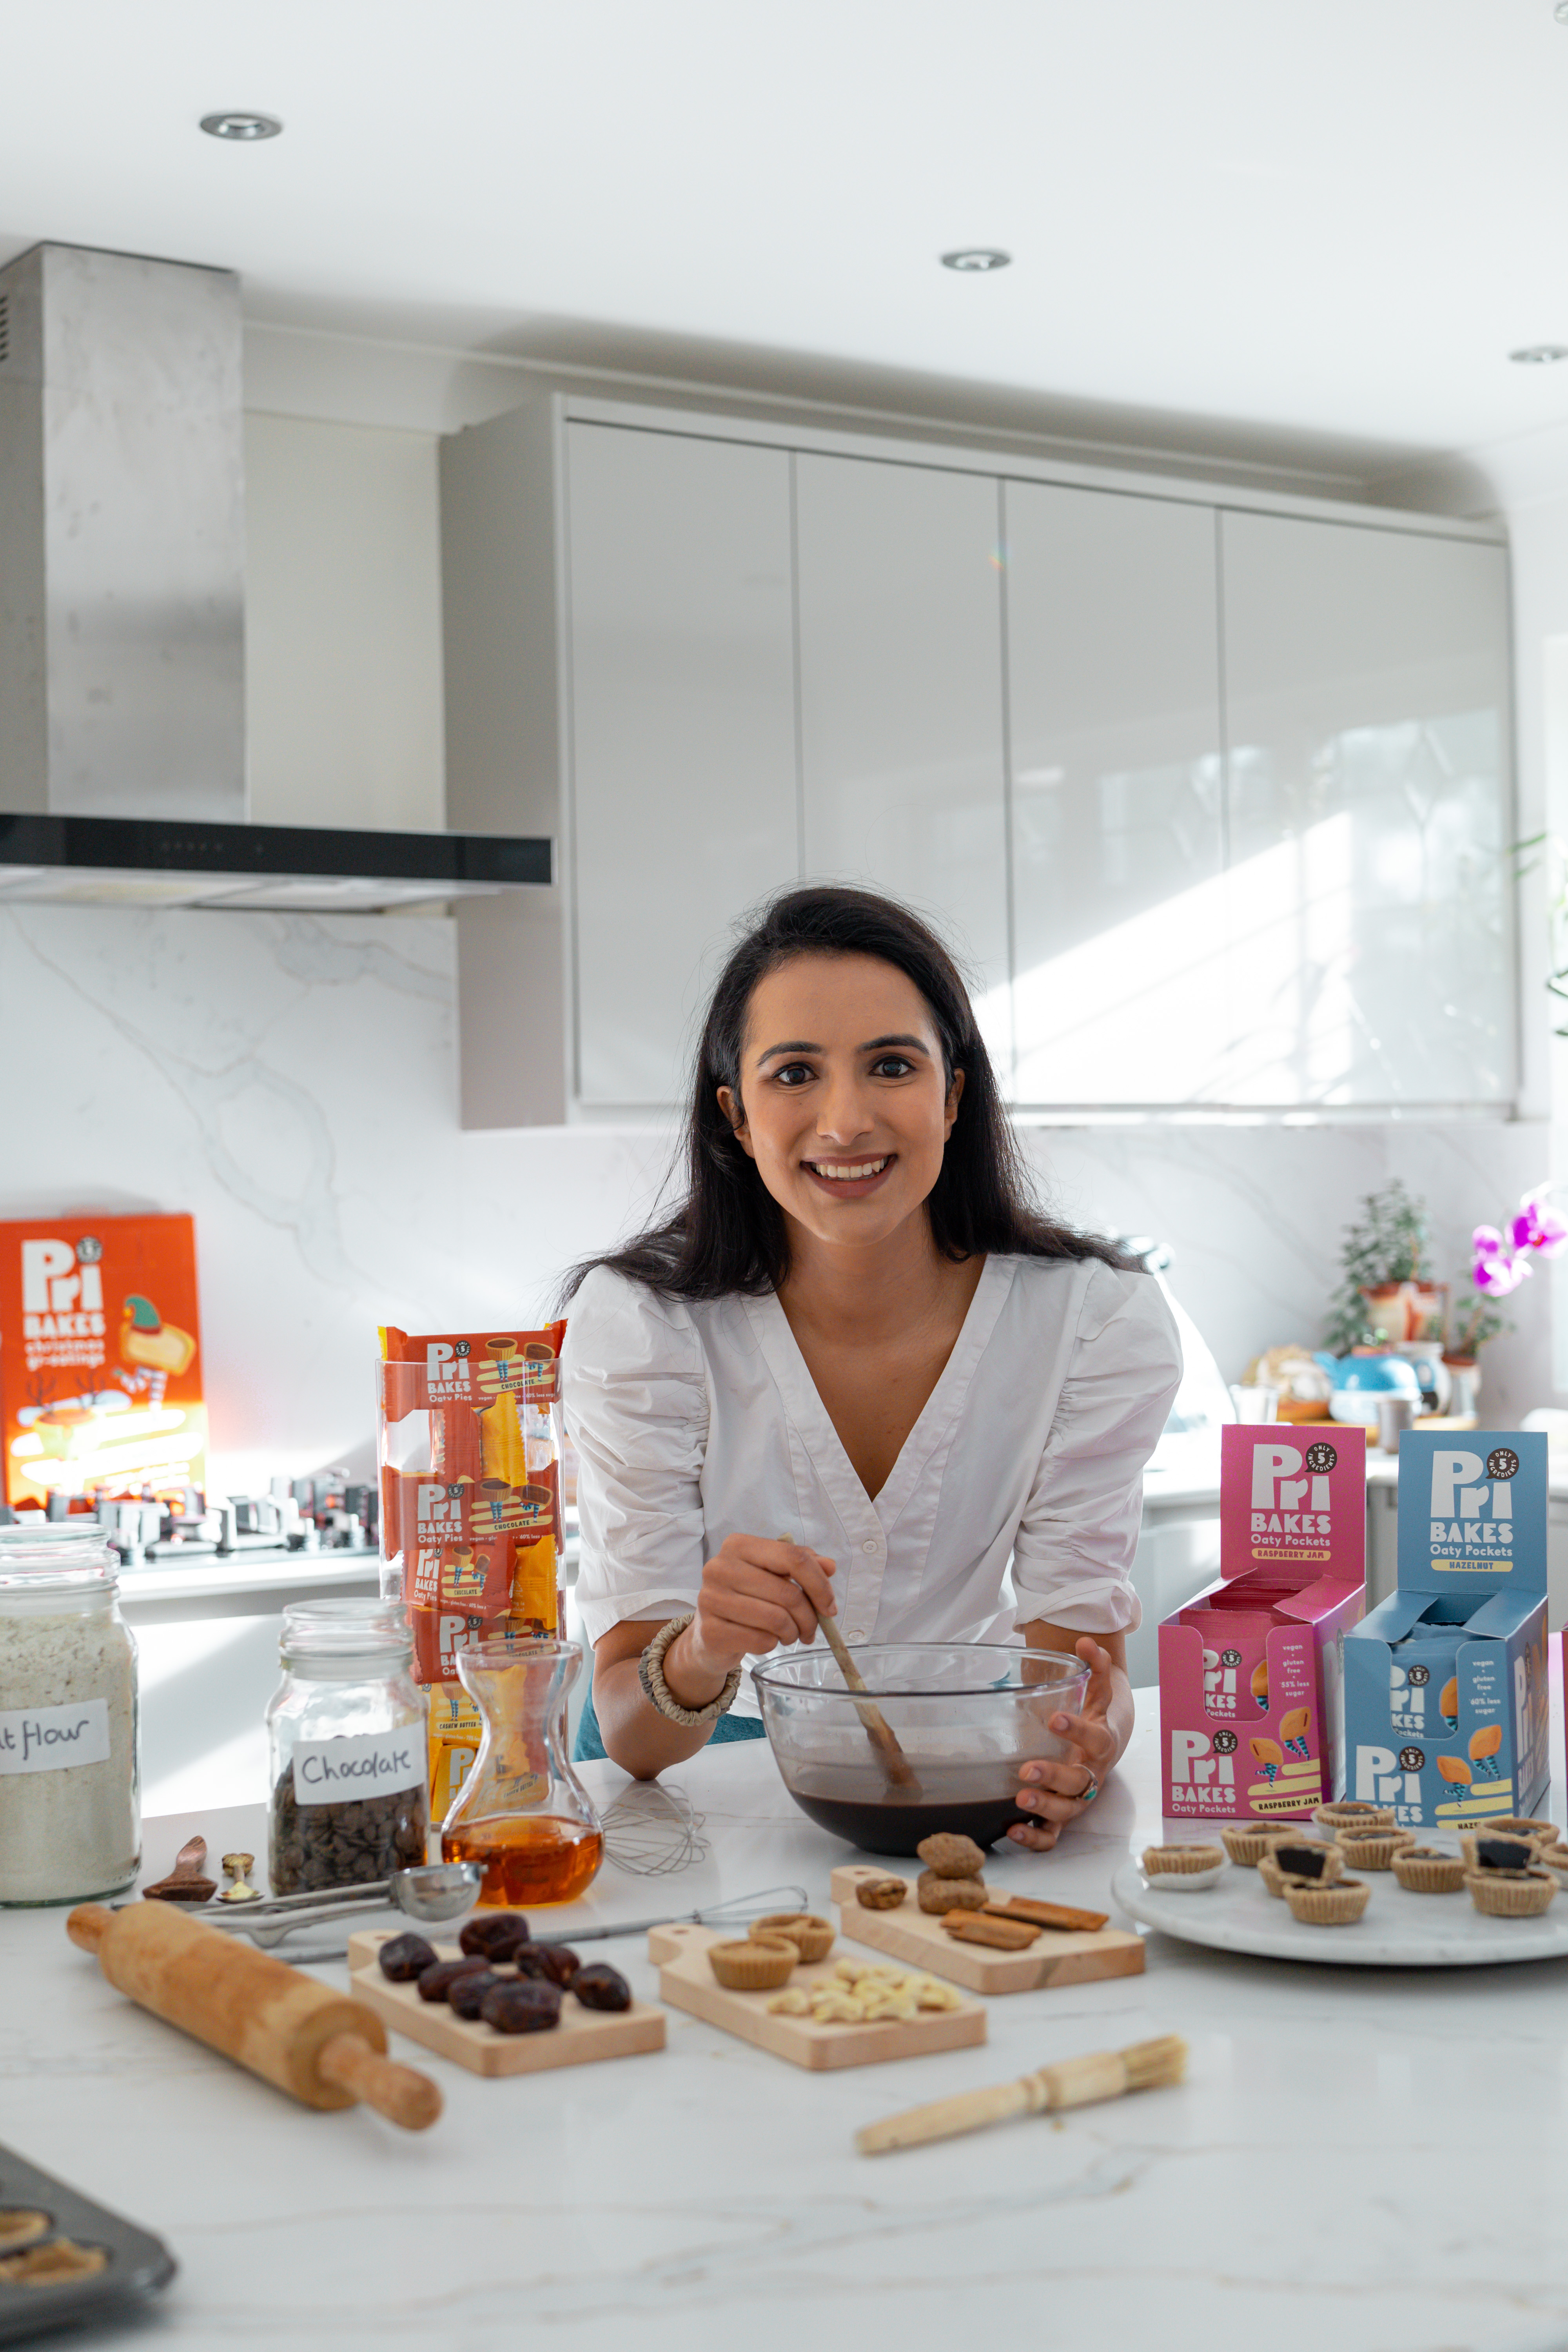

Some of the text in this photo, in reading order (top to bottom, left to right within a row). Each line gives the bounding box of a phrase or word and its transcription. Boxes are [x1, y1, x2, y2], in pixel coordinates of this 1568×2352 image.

[21, 1239, 103, 1312] Pri
[24, 1312, 106, 1339] BAKES
[427, 1343, 470, 1381] Pri
[428, 1381, 471, 1394] BAKES
[501, 1379, 535, 1389] CHOCOLATE
[1308, 1453, 1334, 1471] INGREDIENTS
[1318, 1452, 1325, 1464] 5
[1499, 1458, 1506, 1470] 5
[1489, 1459, 1517, 1477] INGREDIENTS
[1251, 1444, 1330, 1511] Pri
[1430, 1450, 1512, 1519] Pri
[417, 1484, 461, 1521] Pri
[417, 1521, 462, 1534] BAKES
[494, 1520, 530, 1530] CHOCOLATE
[1251, 1513, 1331, 1534] BAKES
[418, 1534, 463, 1544] Oaty Pies
[1251, 1534, 1330, 1547] Oaty Pockets
[1430, 1522, 1513, 1544] BAKES
[1430, 1544, 1512, 1558] Oaty Pockets
[417, 1549, 440, 1579] Pri
[1450, 1561, 1493, 1570] HAZELNUT
[415, 1577, 438, 1592] BAKES
[414, 1590, 437, 1601] Oaty Pies
[440, 1615, 482, 1653] Pri
[1416, 1671, 1421, 1680] 5
[1205, 1693, 1236, 1709] KES
[1392, 1713, 1425, 1730] KES
[23, 1720, 89, 1760] flour
[1214, 1738, 1236, 1753] INGREDIENTS
[1222, 1737, 1229, 1747] 5
[1172, 1730, 1234, 1784] Pri
[1400, 1754, 1424, 1770] INGREDIENTS
[1408, 1754, 1416, 1764] 5
[1356, 1745, 1422, 1803] Pri
[1172, 1786, 1236, 1803] BAKES
[1172, 1803, 1236, 1814] Oaty Pockets
[1259, 1800, 1300, 1810] RASPBERRY
